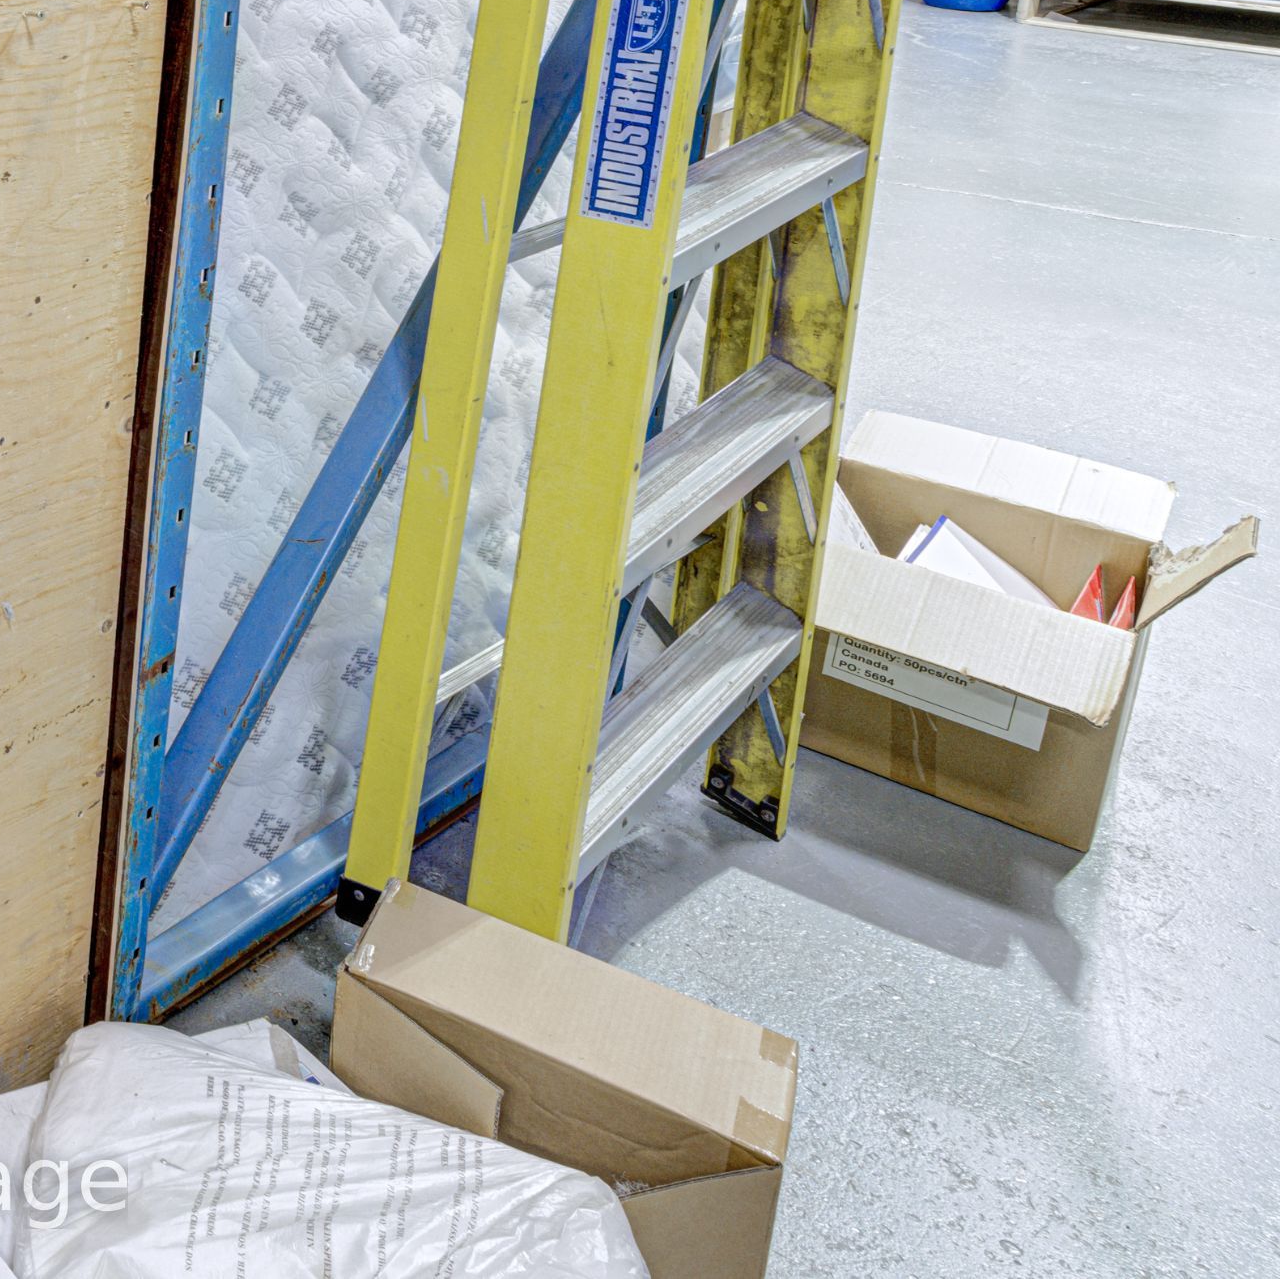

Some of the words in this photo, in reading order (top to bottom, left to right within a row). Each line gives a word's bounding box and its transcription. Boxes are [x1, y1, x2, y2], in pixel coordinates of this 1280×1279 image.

[594, 49, 663, 217] INDUSTRIAL
[838, 659, 861, 674] PO:
[864, 670, 895, 686] 5694
[841, 648, 889, 671] Canada
[843, 636, 901, 664] Quantity:
[903, 659, 968, 687] 50pcs/ctn
